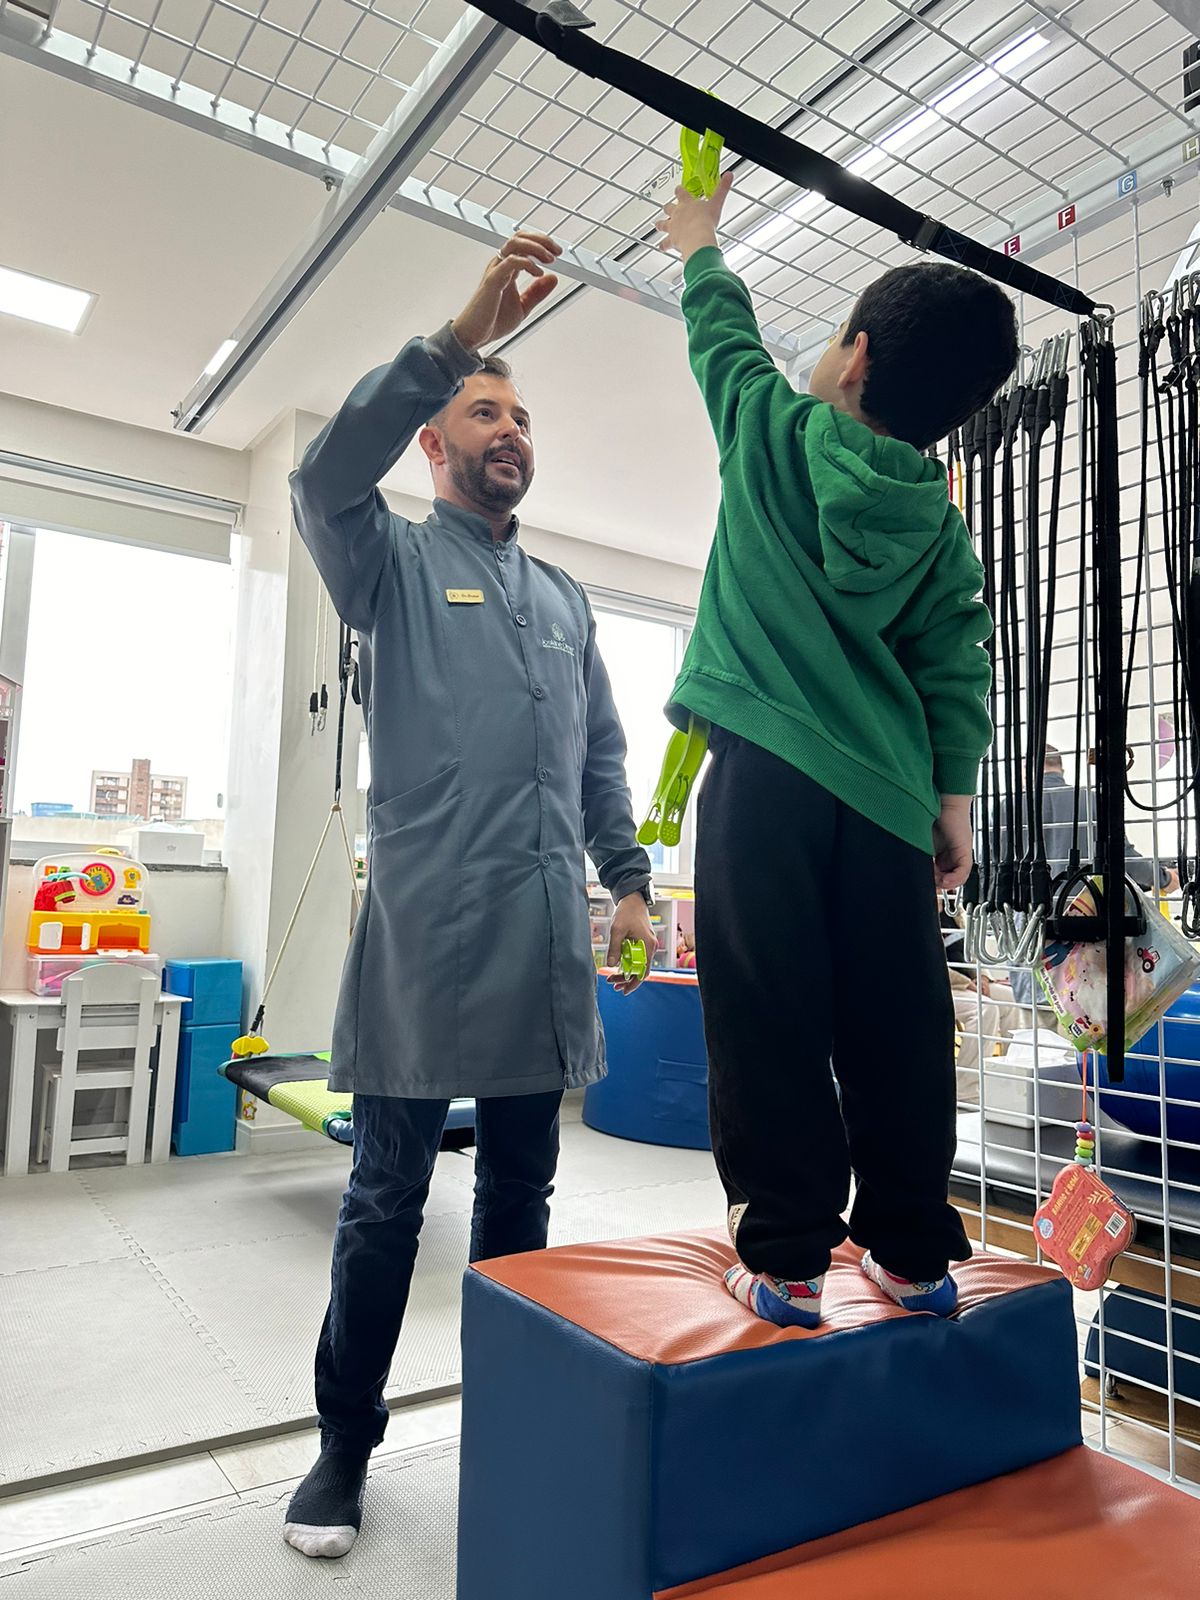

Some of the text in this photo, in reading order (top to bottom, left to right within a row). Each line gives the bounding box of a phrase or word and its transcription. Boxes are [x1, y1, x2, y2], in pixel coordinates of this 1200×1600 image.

[1186, 138, 1200, 160] H
[1121, 175, 1134, 192] G
[1062, 209, 1072, 226] F
[1007, 239, 1017, 255] E
